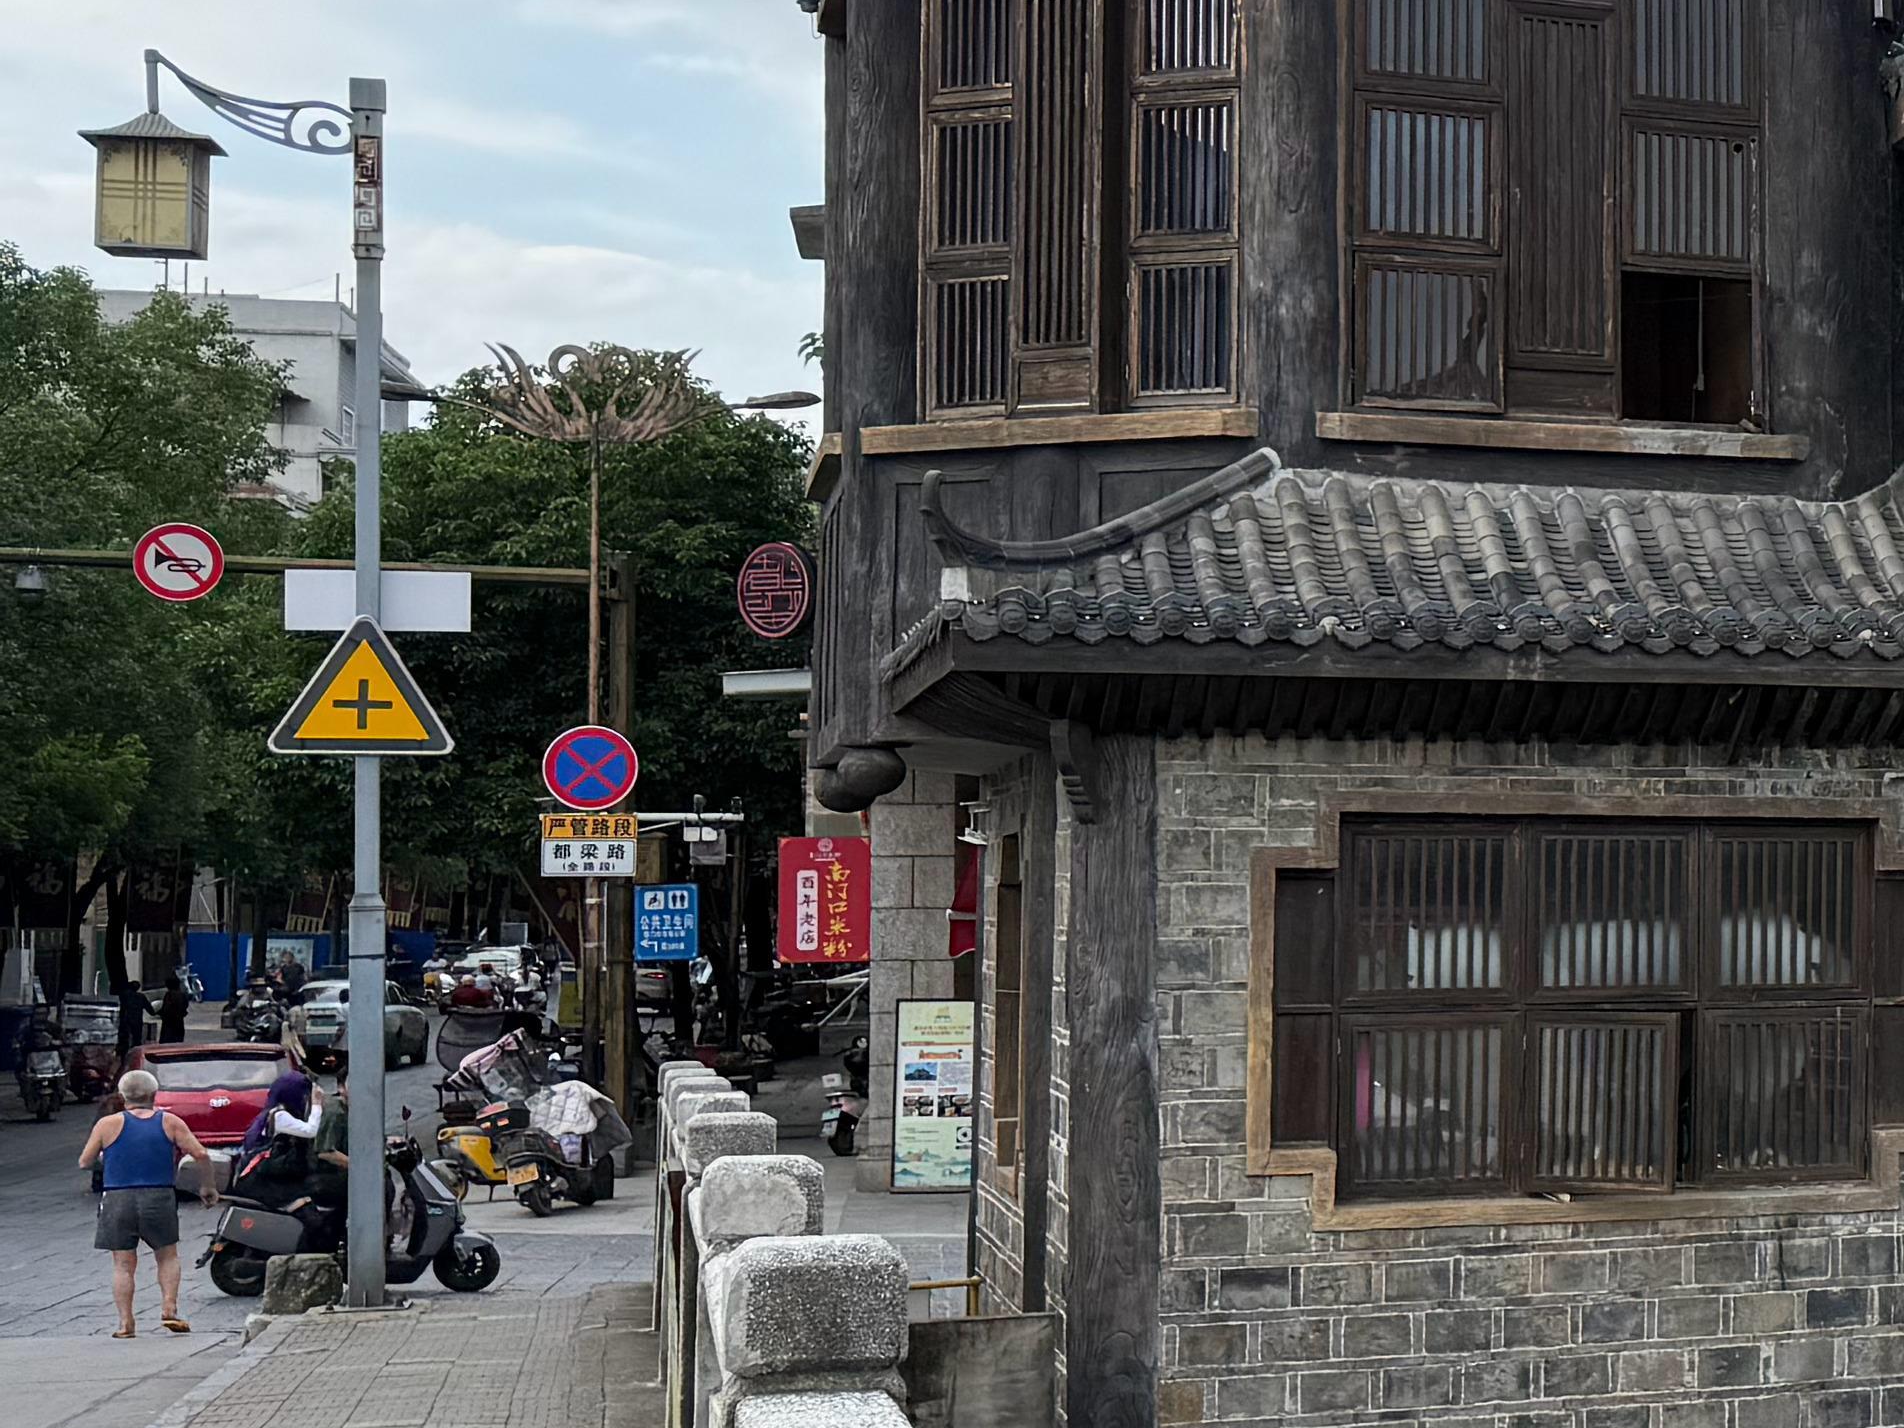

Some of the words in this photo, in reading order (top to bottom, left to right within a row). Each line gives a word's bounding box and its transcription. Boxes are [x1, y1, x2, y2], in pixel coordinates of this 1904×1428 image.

[548, 818, 632, 836] 严管路段
[553, 843, 625, 860] 都梁路
[799, 875, 816, 945] 百年老店
[822, 861, 853, 958] 南门口米粉
[640, 914, 694, 930] 公共卫生间
